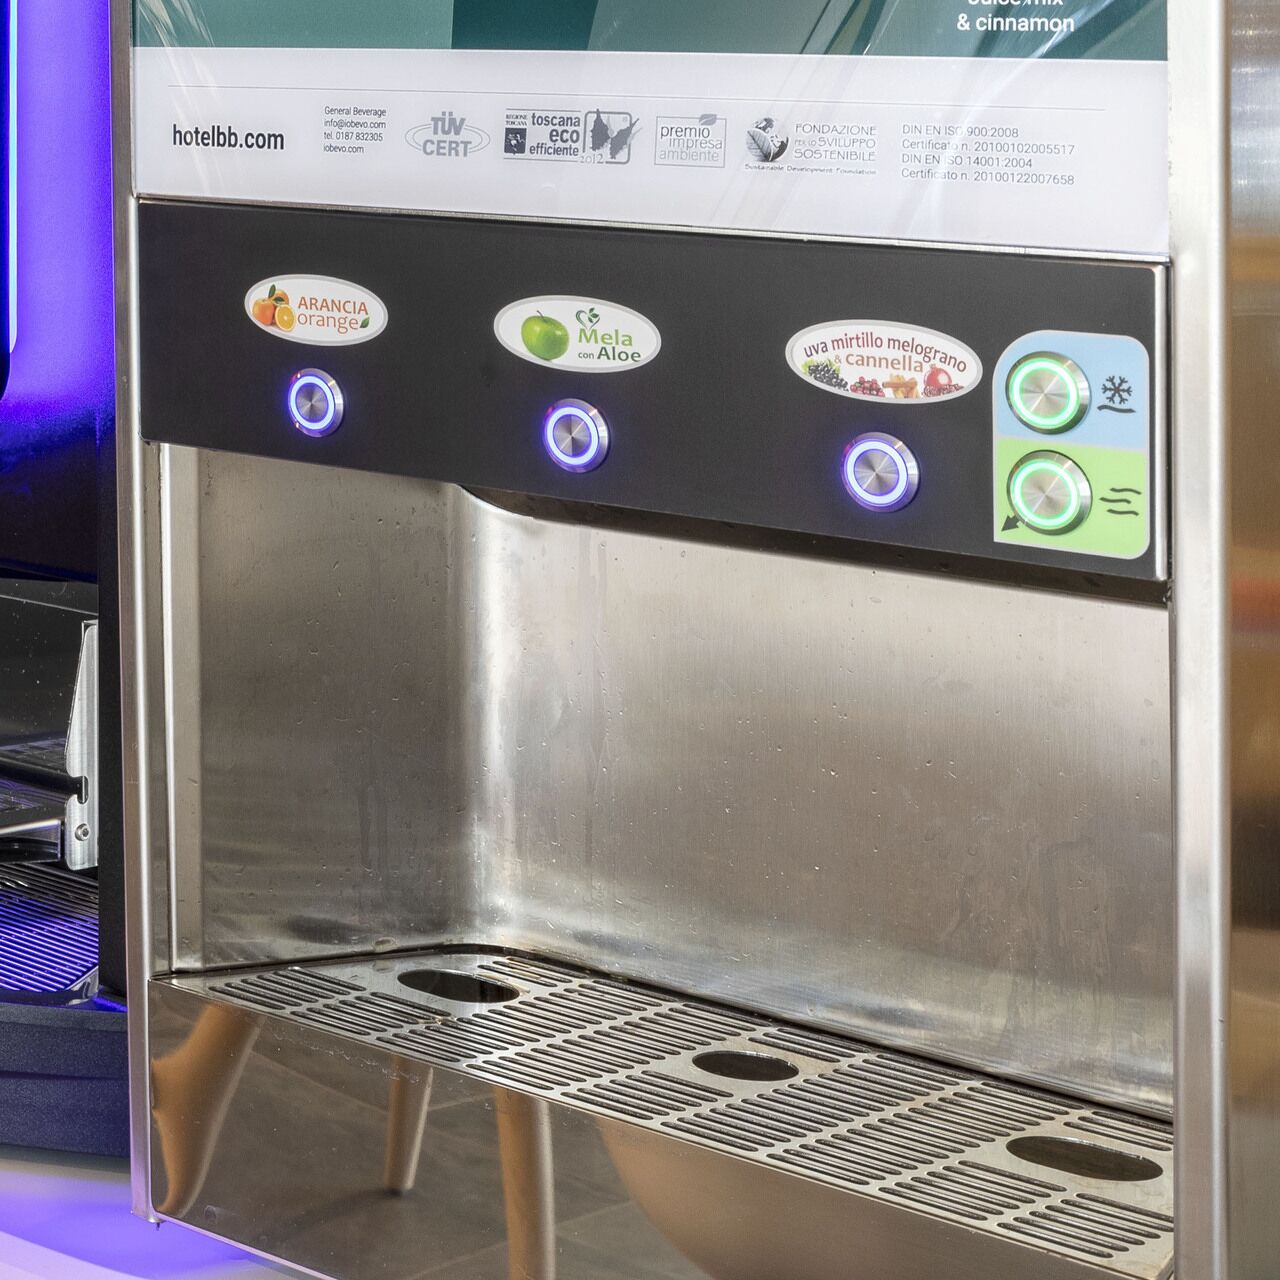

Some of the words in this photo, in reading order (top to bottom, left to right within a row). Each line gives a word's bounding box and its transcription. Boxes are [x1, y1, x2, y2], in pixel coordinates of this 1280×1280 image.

[956, 15, 971, 31] &
[976, 13, 1075, 33] cinnamon
[324, 106, 351, 115] General
[353, 107, 386, 118] Beverage
[324, 119, 386, 130] info@iobevo.com
[431, 112, 466, 136] TÜV
[531, 113, 581, 127] toscana
[336, 132, 353, 140] 0187
[355, 132, 383, 141] 832305
[549, 129, 580, 143] eco
[660, 125, 710, 141] premio
[796, 124, 876, 135] FONDAZIONE
[902, 124, 922, 134] DIN
[926, 125, 941, 135] EN
[945, 126, 963, 136] ISO
[172, 124, 285, 150] hotelbb.com
[669, 137, 722, 150] impresa
[818, 137, 876, 148] SVILUPPO
[324, 144, 364, 153] iobevo.com
[422, 139, 472, 157] CERT
[529, 143, 579, 157] efficiente
[962, 143, 971, 151] n.
[659, 149, 719, 161] ambiente
[794, 149, 876, 161] SOSTENIBILE
[902, 154, 922, 163] DIN
[925, 154, 940, 164] EN
[961, 172, 970, 180] n.
[297, 295, 369, 315] ARANCIA
[297, 311, 359, 335] orange
[578, 327, 633, 347] Mela
[577, 351, 595, 360] con
[597, 346, 641, 363] Aloe
[804, 341, 828, 359] uva
[831, 332, 884, 350] mirtillo
[886, 335, 967, 374] melograno
[845, 352, 924, 374] cannella
